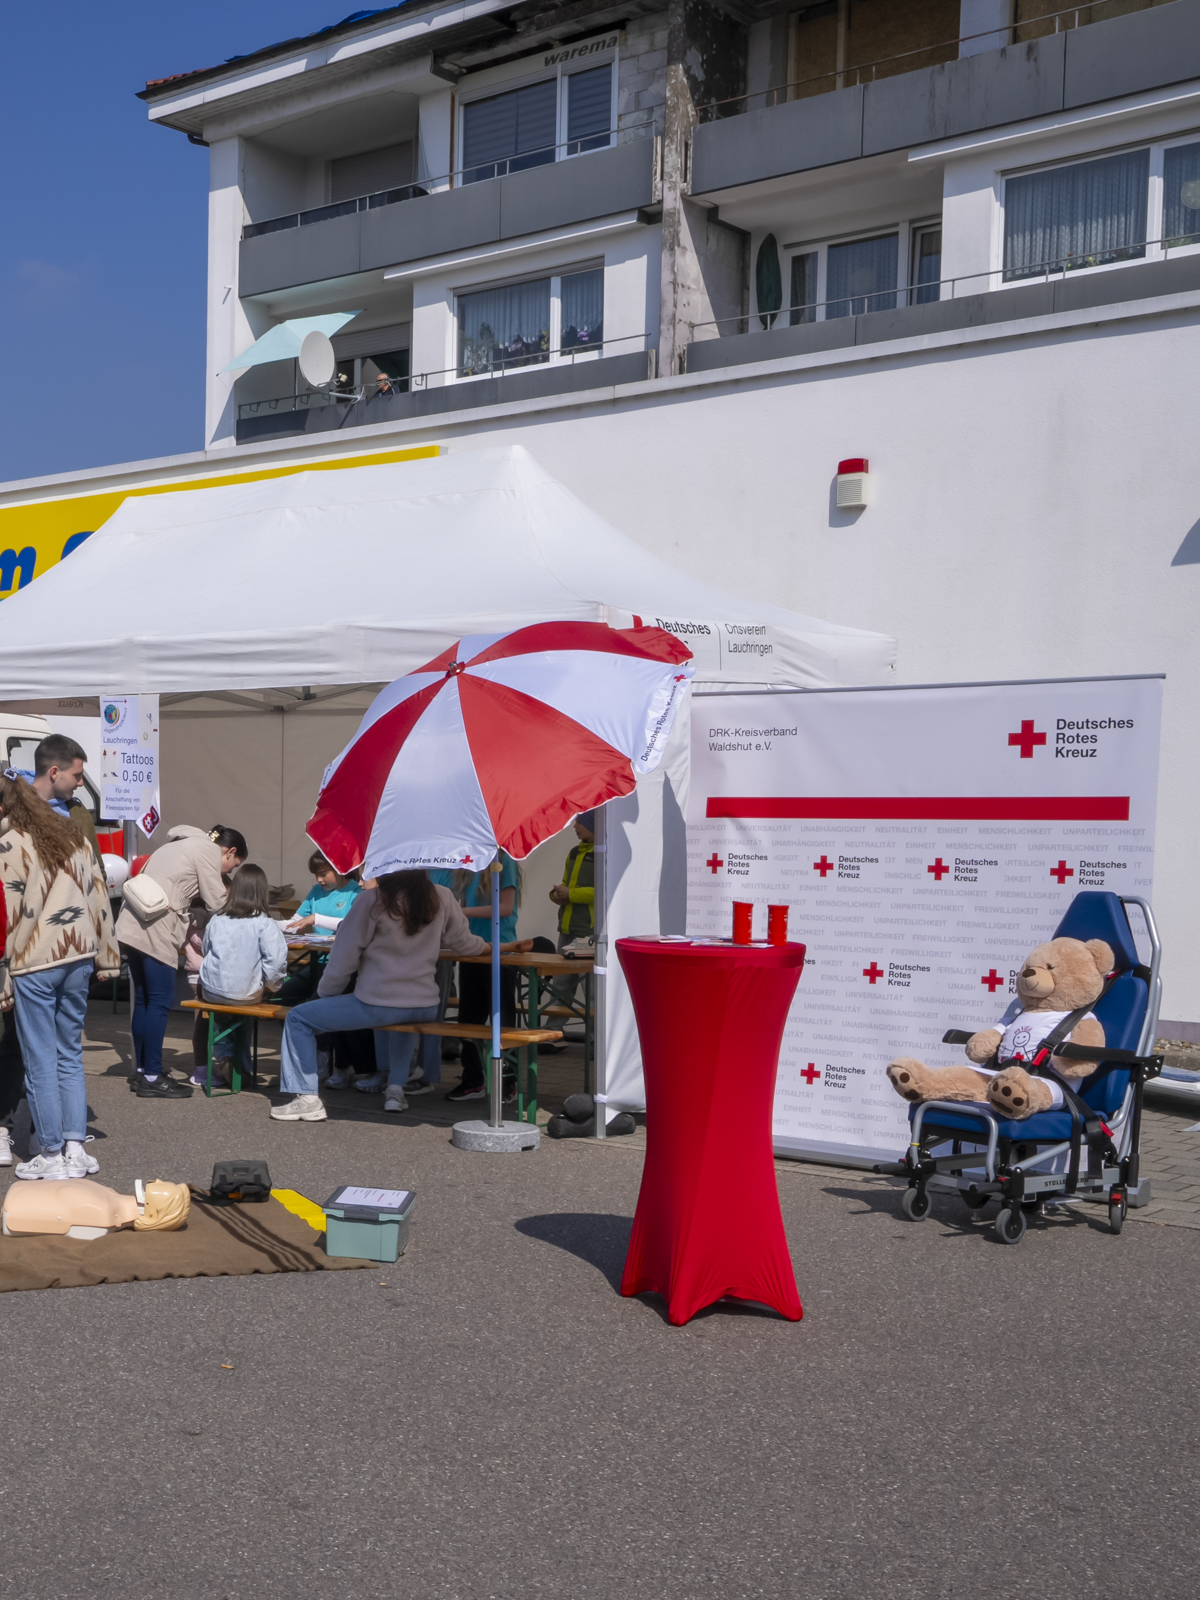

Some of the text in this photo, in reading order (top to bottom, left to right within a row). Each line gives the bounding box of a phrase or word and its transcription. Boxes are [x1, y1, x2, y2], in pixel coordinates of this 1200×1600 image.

[544, 35, 618, 67] warema
[654, 618, 711, 635] Deutsches
[724, 623, 766, 635] Ortsverein
[727, 640, 773, 656] Lauchringen
[1056, 717, 1134, 730] Deutsches
[709, 726, 798, 738] DRK-Kreisverband
[103, 736, 138, 746] Lauchringen
[1056, 732, 1098, 744] Rotes
[640, 725, 662, 762] Deutsches
[709, 742, 773, 751] Waldshut e.V.
[1055, 746, 1097, 758] Kreuz
[121, 752, 154, 765] Tattoos
[122, 770, 153, 783] 0,50 €
[433, 856, 457, 864] Kreuz
[728, 852, 768, 861] Deutsches
[838, 855, 879, 864] Deutsches
[838, 863, 861, 871] Rotes
[955, 858, 999, 867] Deutsches
[1079, 860, 1127, 869] Deutsches
[955, 866, 978, 874] Rotes
[1079, 869, 1105, 877] Rotes
[838, 871, 860, 879] Kreuz
[954, 874, 978, 882] Kreuz
[1078, 877, 1105, 886] Kreuz
[889, 962, 931, 972] Deutsches
[889, 971, 912, 979] Rotes
[888, 979, 911, 988] Kreuz
[825, 1064, 866, 1075] Deutsches
[825, 1072, 847, 1081] Rotes
[824, 1080, 847, 1089] Kreuz
[824, 1094, 852, 1103] EINHEIT
